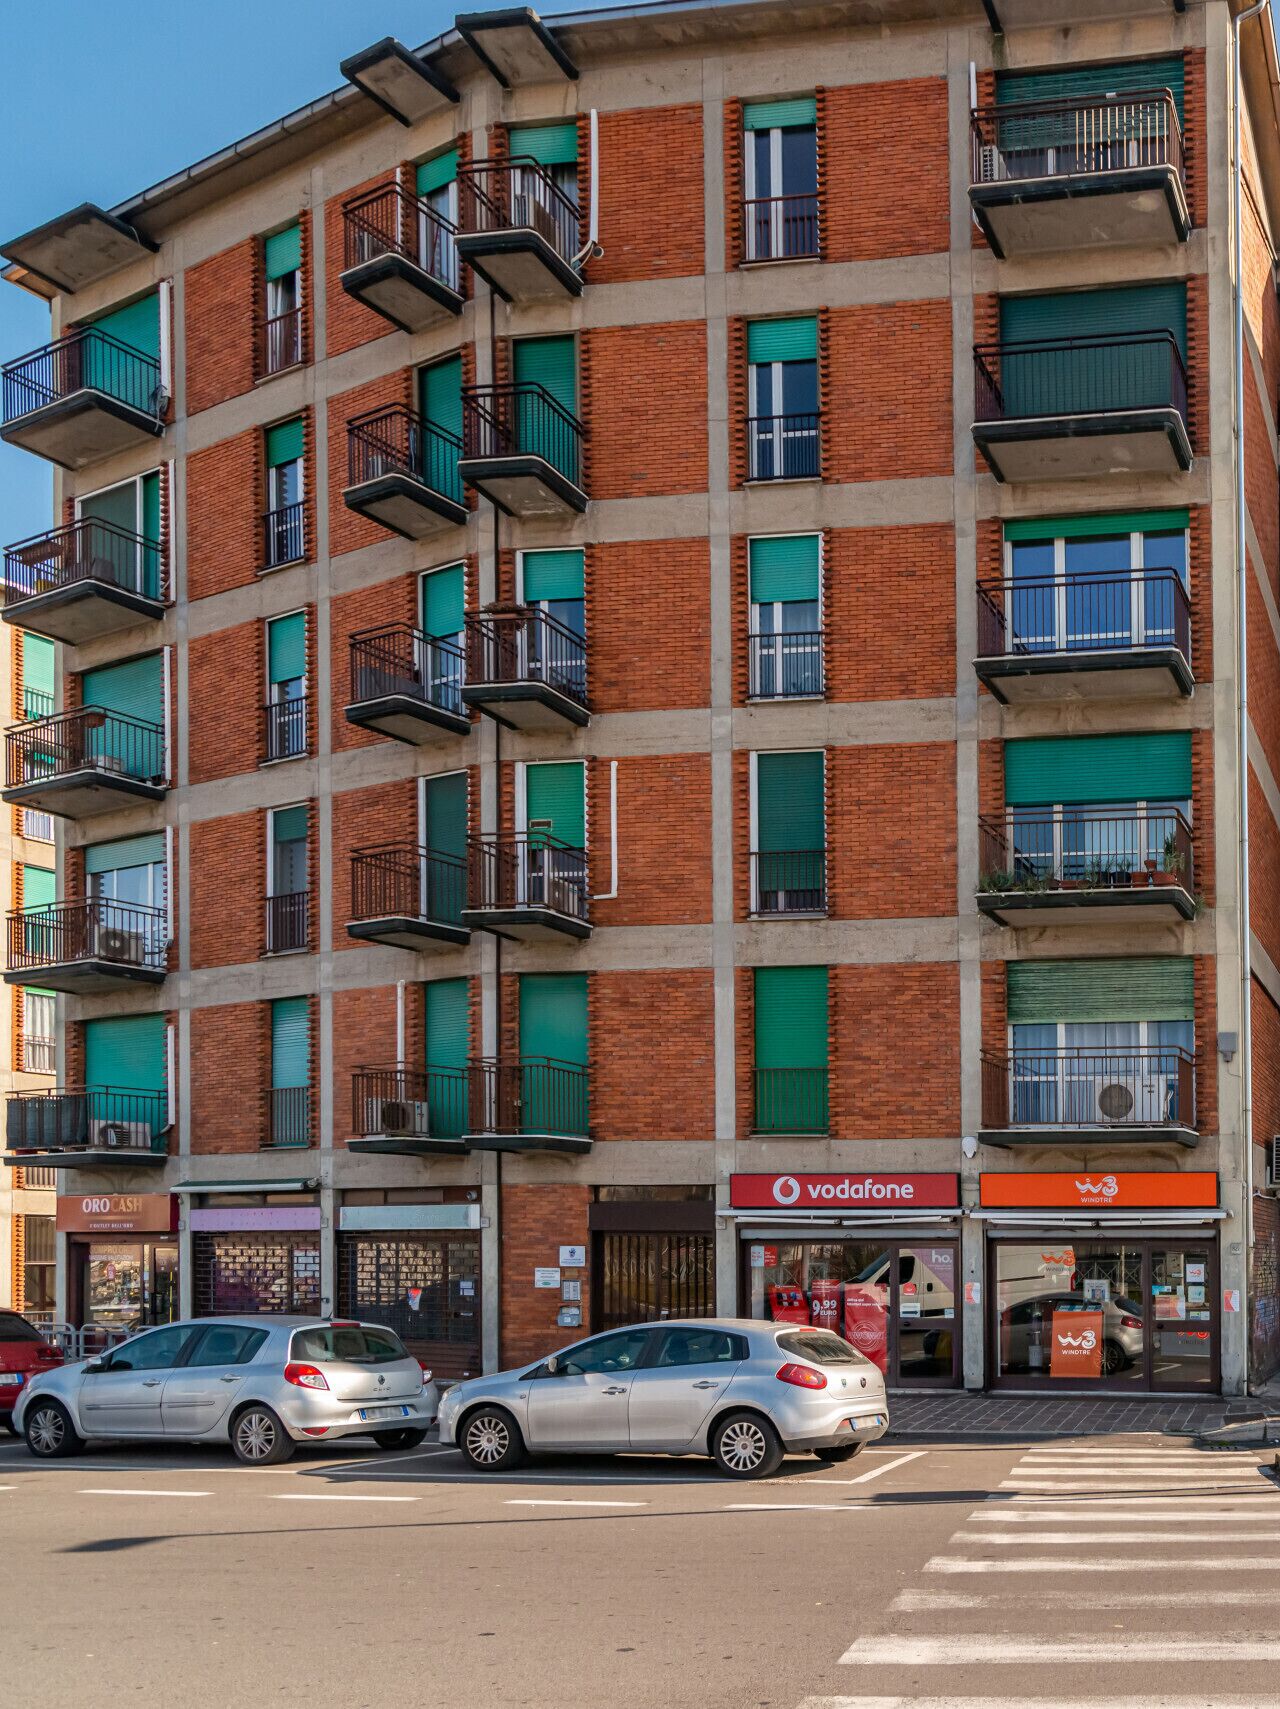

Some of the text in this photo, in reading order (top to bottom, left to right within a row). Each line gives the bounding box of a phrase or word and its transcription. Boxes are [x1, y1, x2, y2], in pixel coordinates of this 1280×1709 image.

[808, 1179, 914, 1199] vodafone
[82, 1198, 143, 1213] ORO CASH
